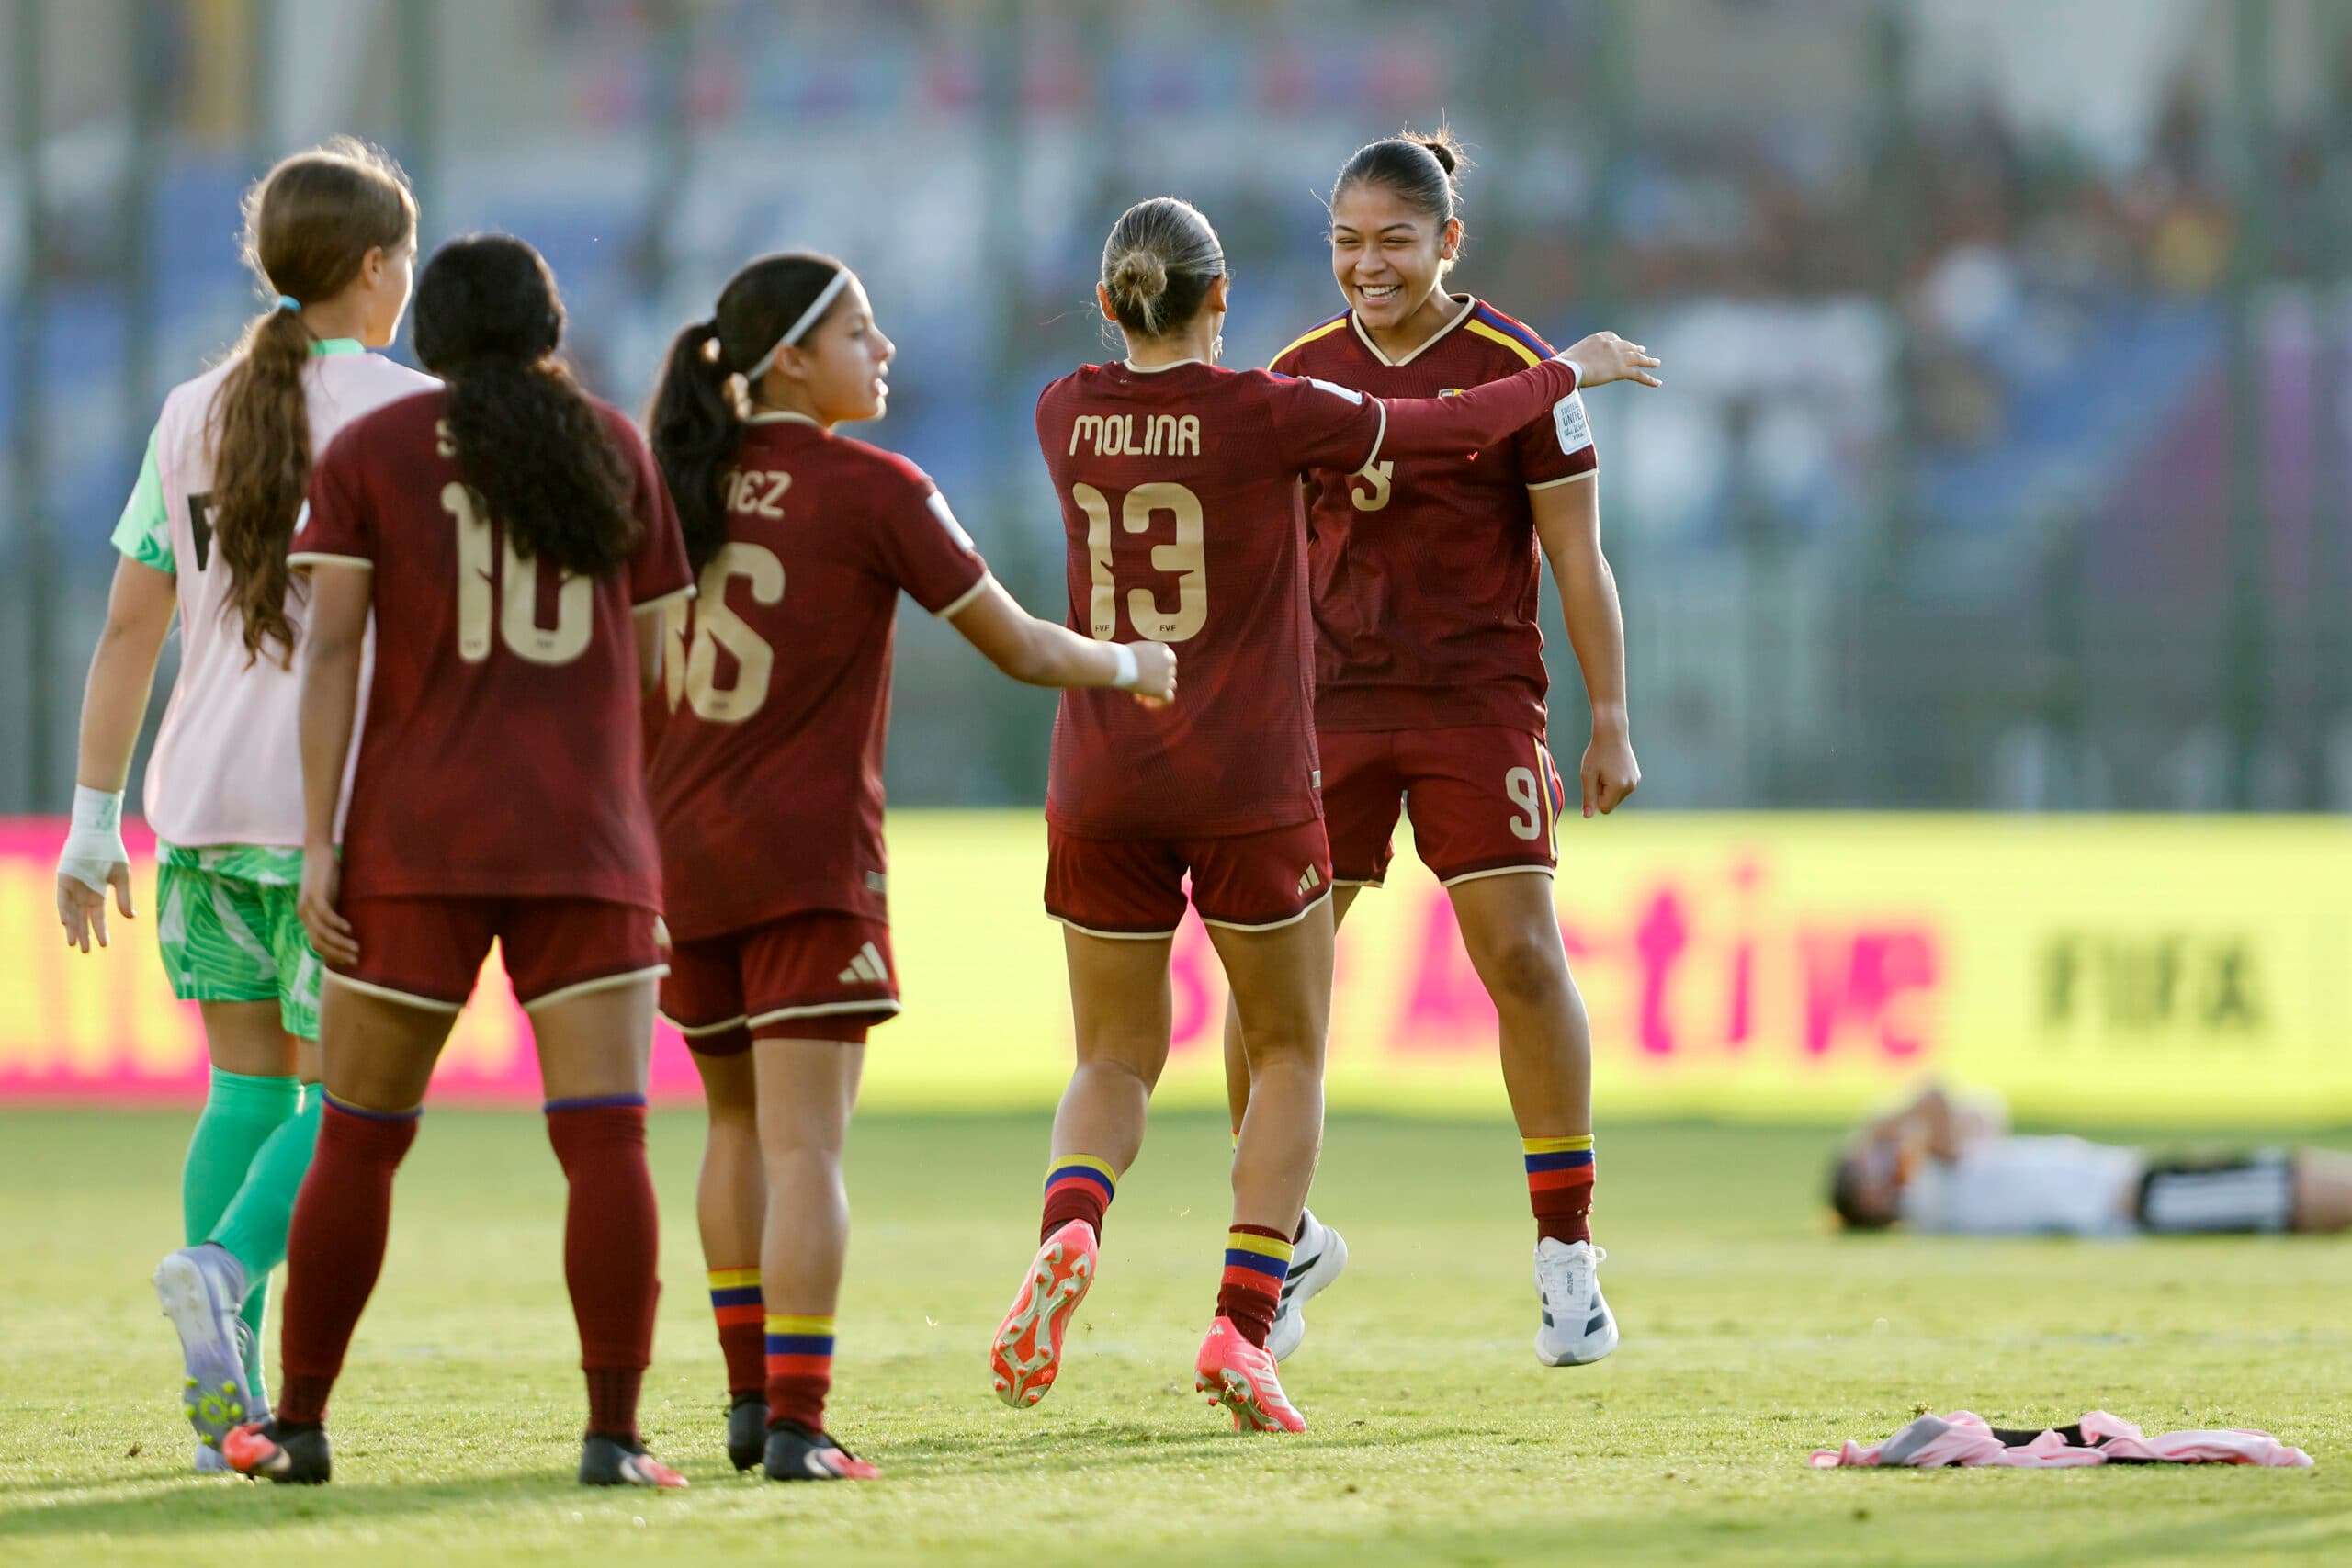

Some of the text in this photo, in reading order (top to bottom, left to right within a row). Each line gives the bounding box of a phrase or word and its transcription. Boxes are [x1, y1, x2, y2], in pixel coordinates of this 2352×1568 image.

[1069, 414, 1200, 456] MOLINA
[1072, 482, 1207, 641] 13
[1505, 766, 1541, 840] 9
[1391, 862, 1940, 1054] Ative
[2040, 928, 2271, 1031] FIFA
